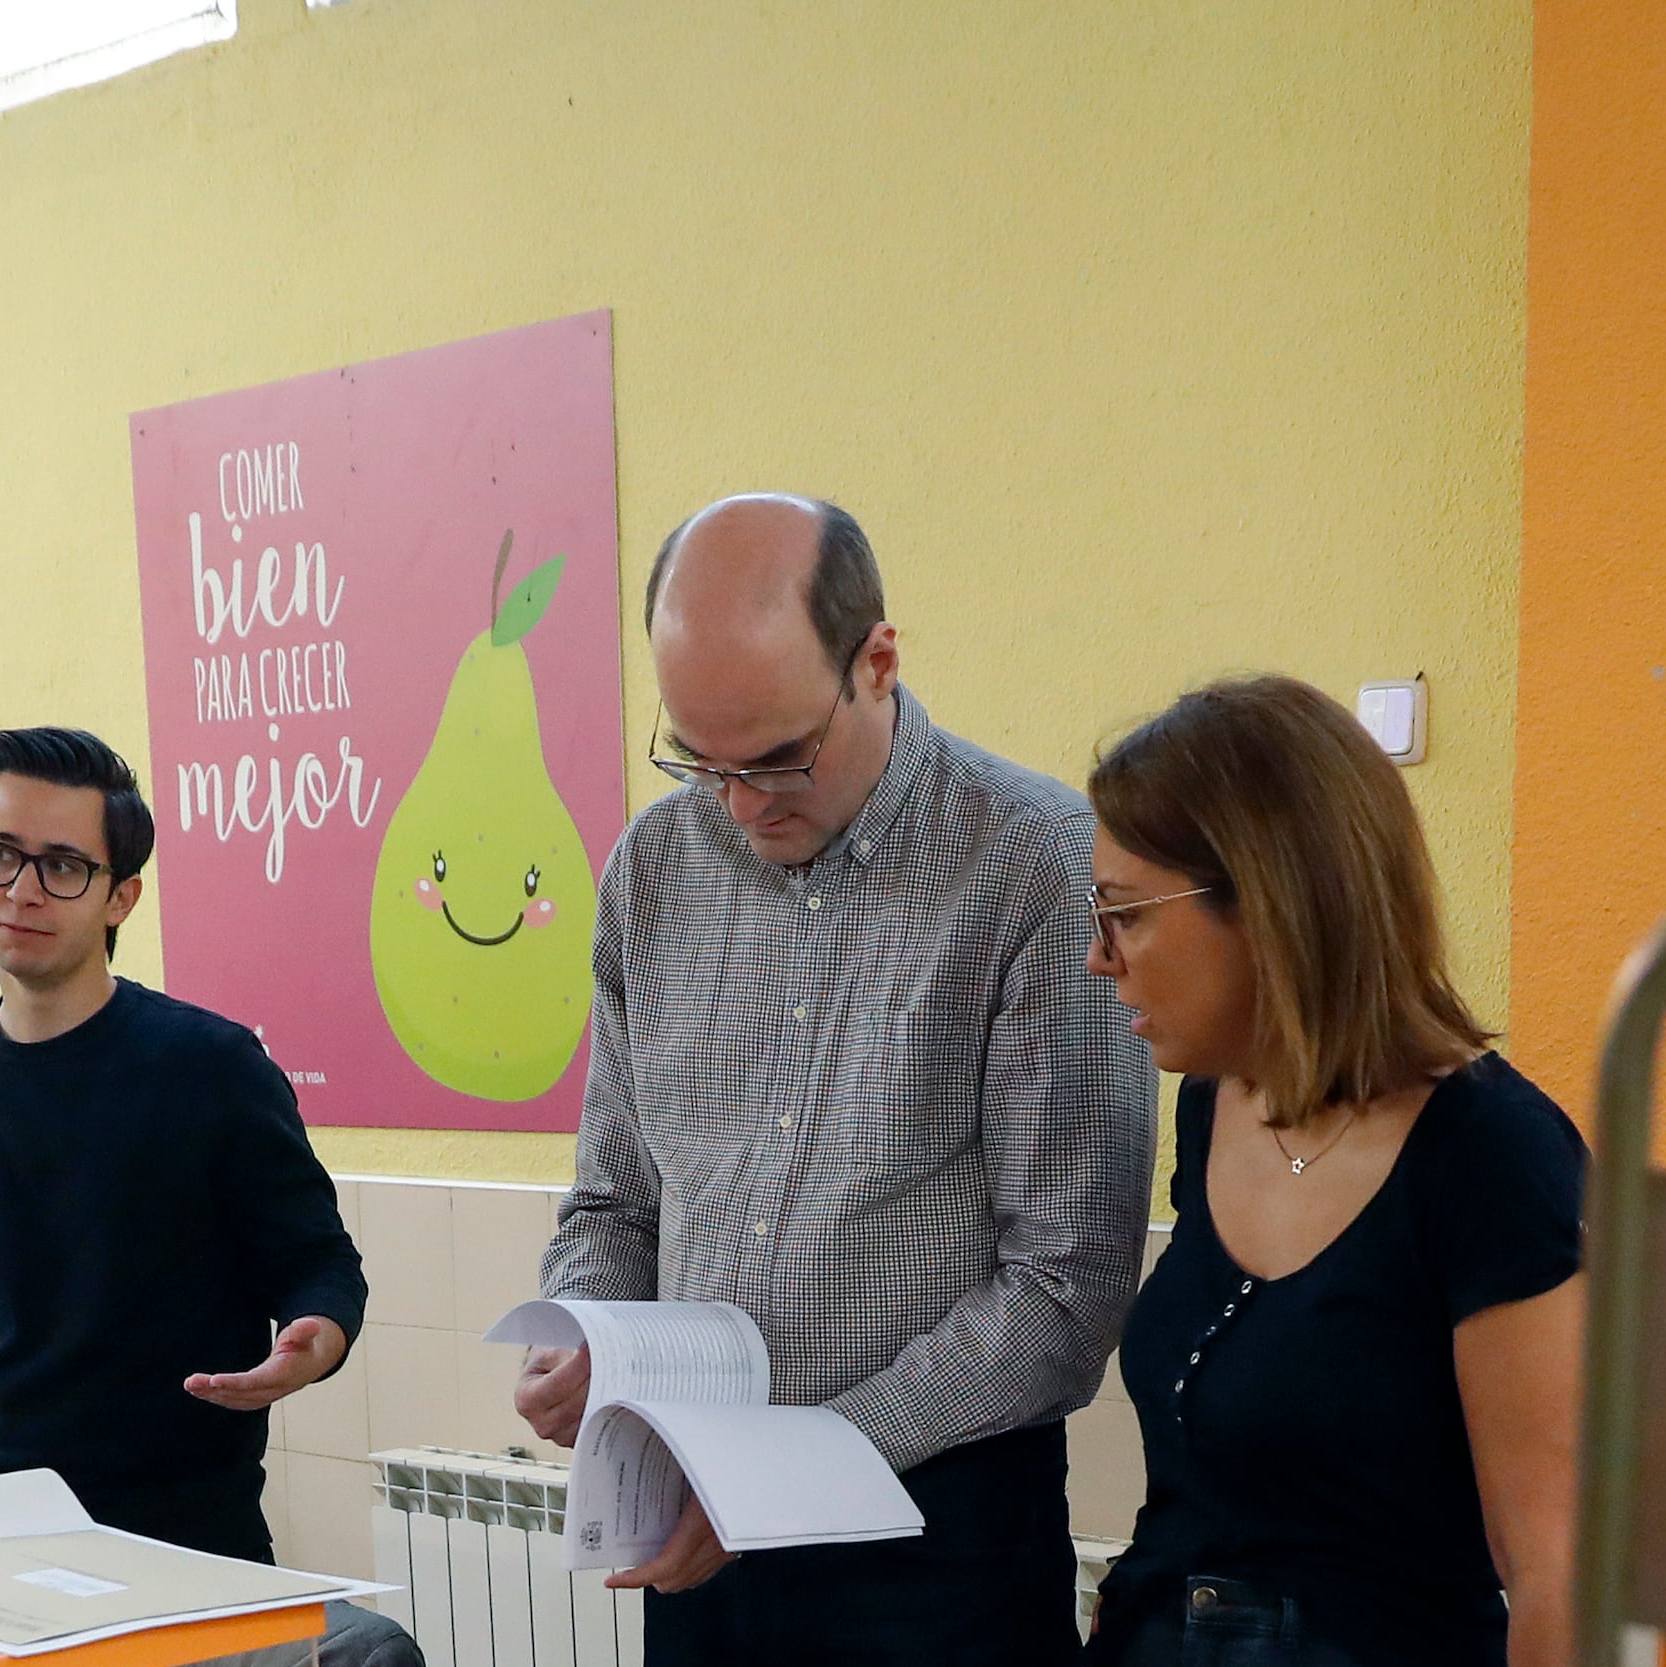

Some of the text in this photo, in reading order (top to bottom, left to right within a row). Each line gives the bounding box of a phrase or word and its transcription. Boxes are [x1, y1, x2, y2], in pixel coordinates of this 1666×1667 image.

[218, 441, 304, 522] COMER
[188, 511, 346, 644] bien
[193, 640, 351, 724] PARA CRECER
[177, 722, 383, 884] mejor
[305, 1071, 326, 1083] VIDA
